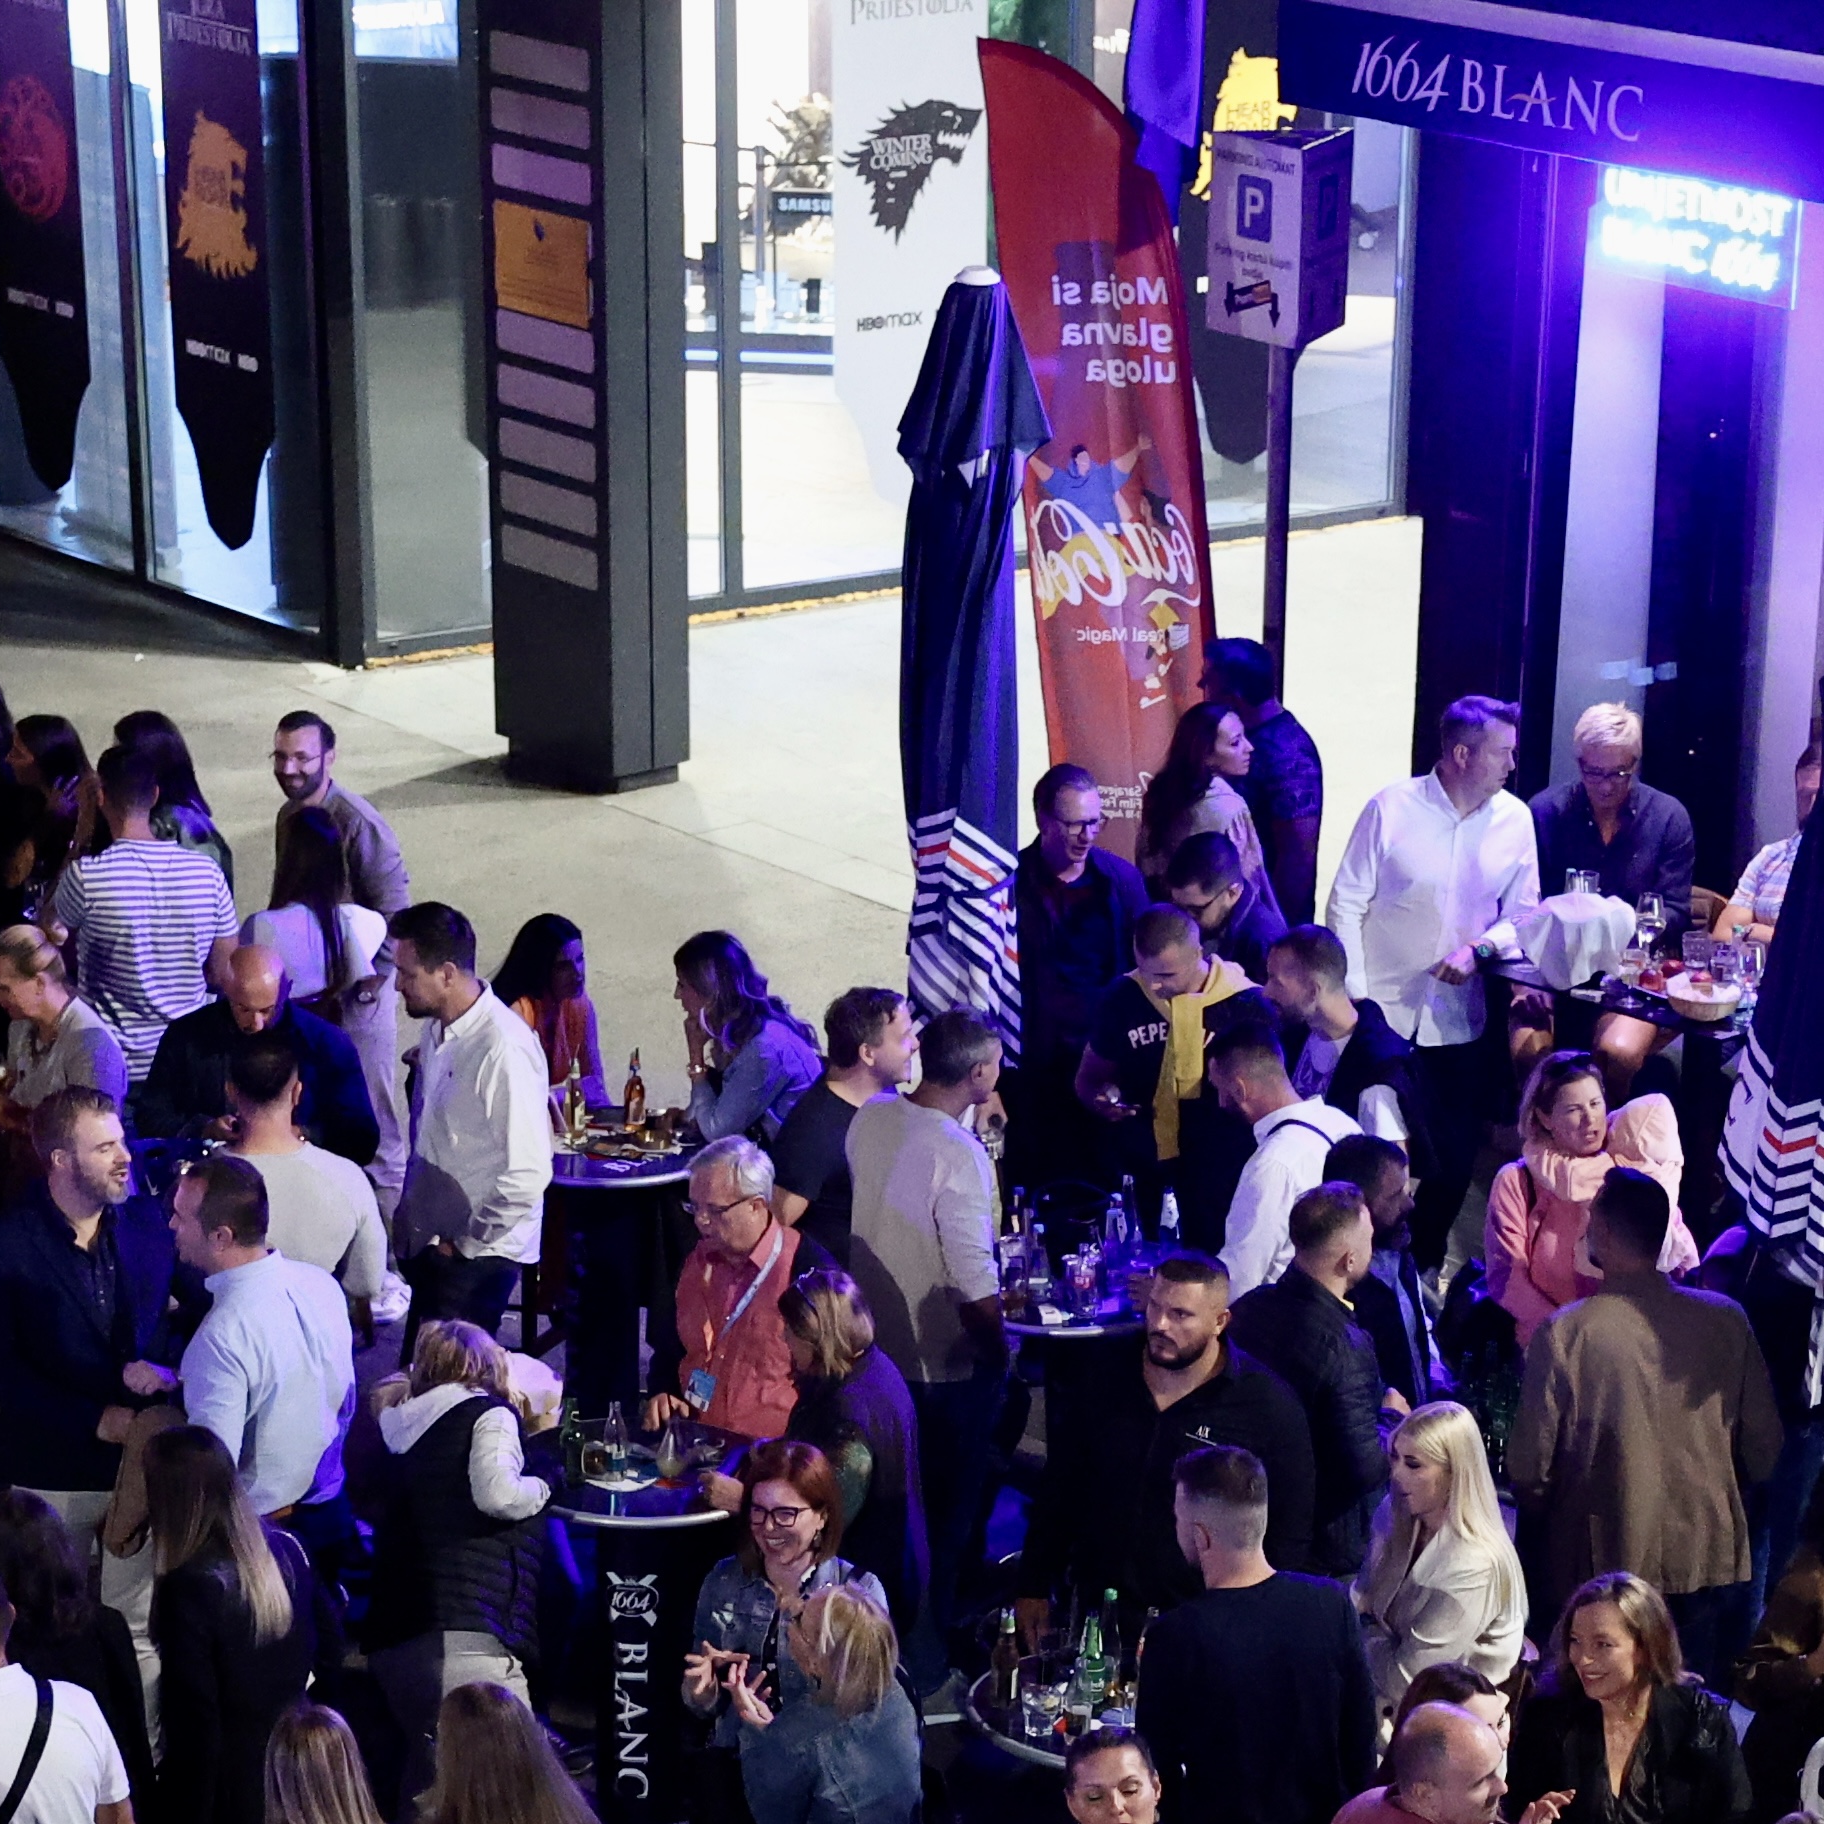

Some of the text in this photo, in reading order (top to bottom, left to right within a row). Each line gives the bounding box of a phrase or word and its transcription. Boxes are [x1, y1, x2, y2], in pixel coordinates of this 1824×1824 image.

[1350, 35, 1645, 143] 1664 BLANC
[870, 134, 932, 154] WINTER
[870, 151, 934, 171] COMING
[778, 197, 833, 213] SAMSU
[1244, 187, 1265, 228] P
[1128, 1021, 1168, 1049] PEPE
[611, 1591, 652, 1611] 1664
[614, 1641, 649, 1799] BLANC
